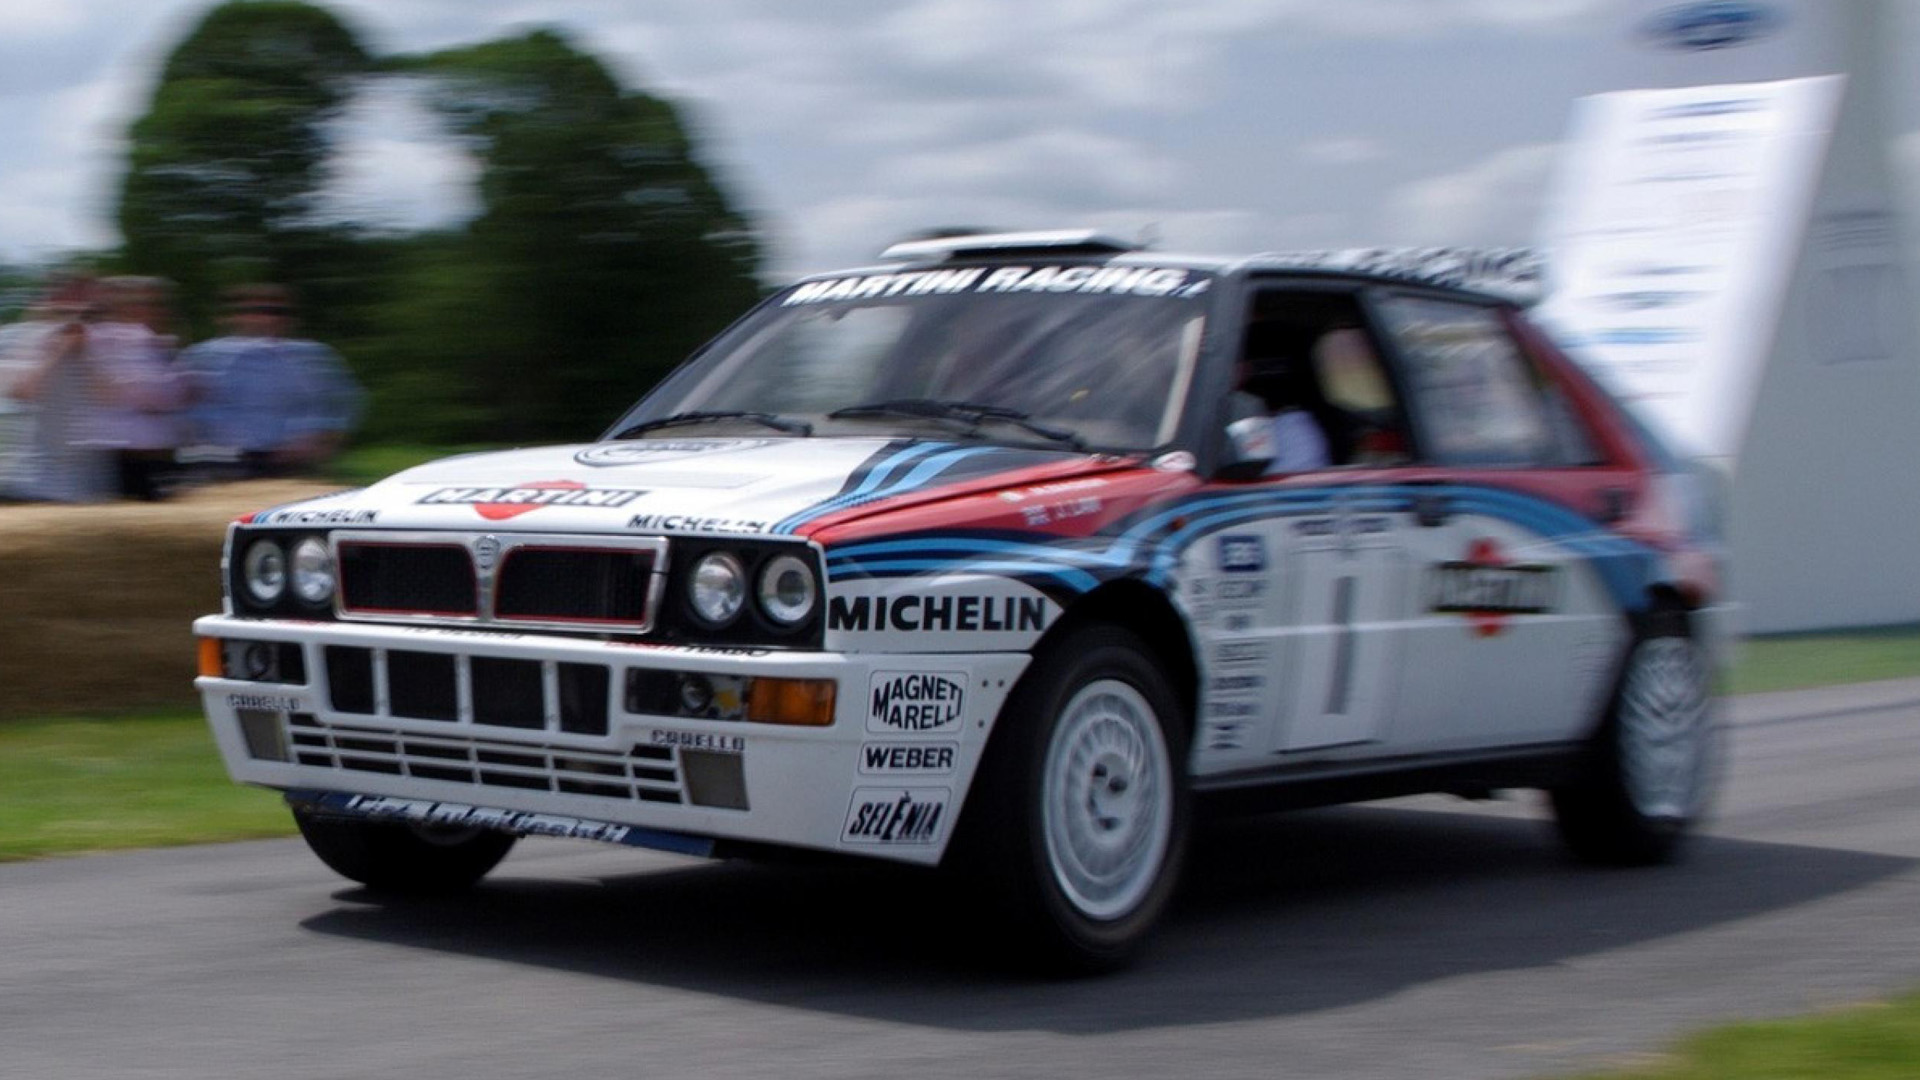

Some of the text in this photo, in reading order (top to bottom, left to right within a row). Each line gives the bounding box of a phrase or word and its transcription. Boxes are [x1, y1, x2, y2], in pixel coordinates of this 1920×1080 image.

[781, 266, 1189, 307] MARTINI RACING
[416, 488, 650, 507] MARTINI
[276, 510, 380, 523] MICHELIN
[627, 514, 768, 534] MICHELIN
[828, 596, 1046, 631] MICHELIN
[866, 747, 954, 769] WEBER
